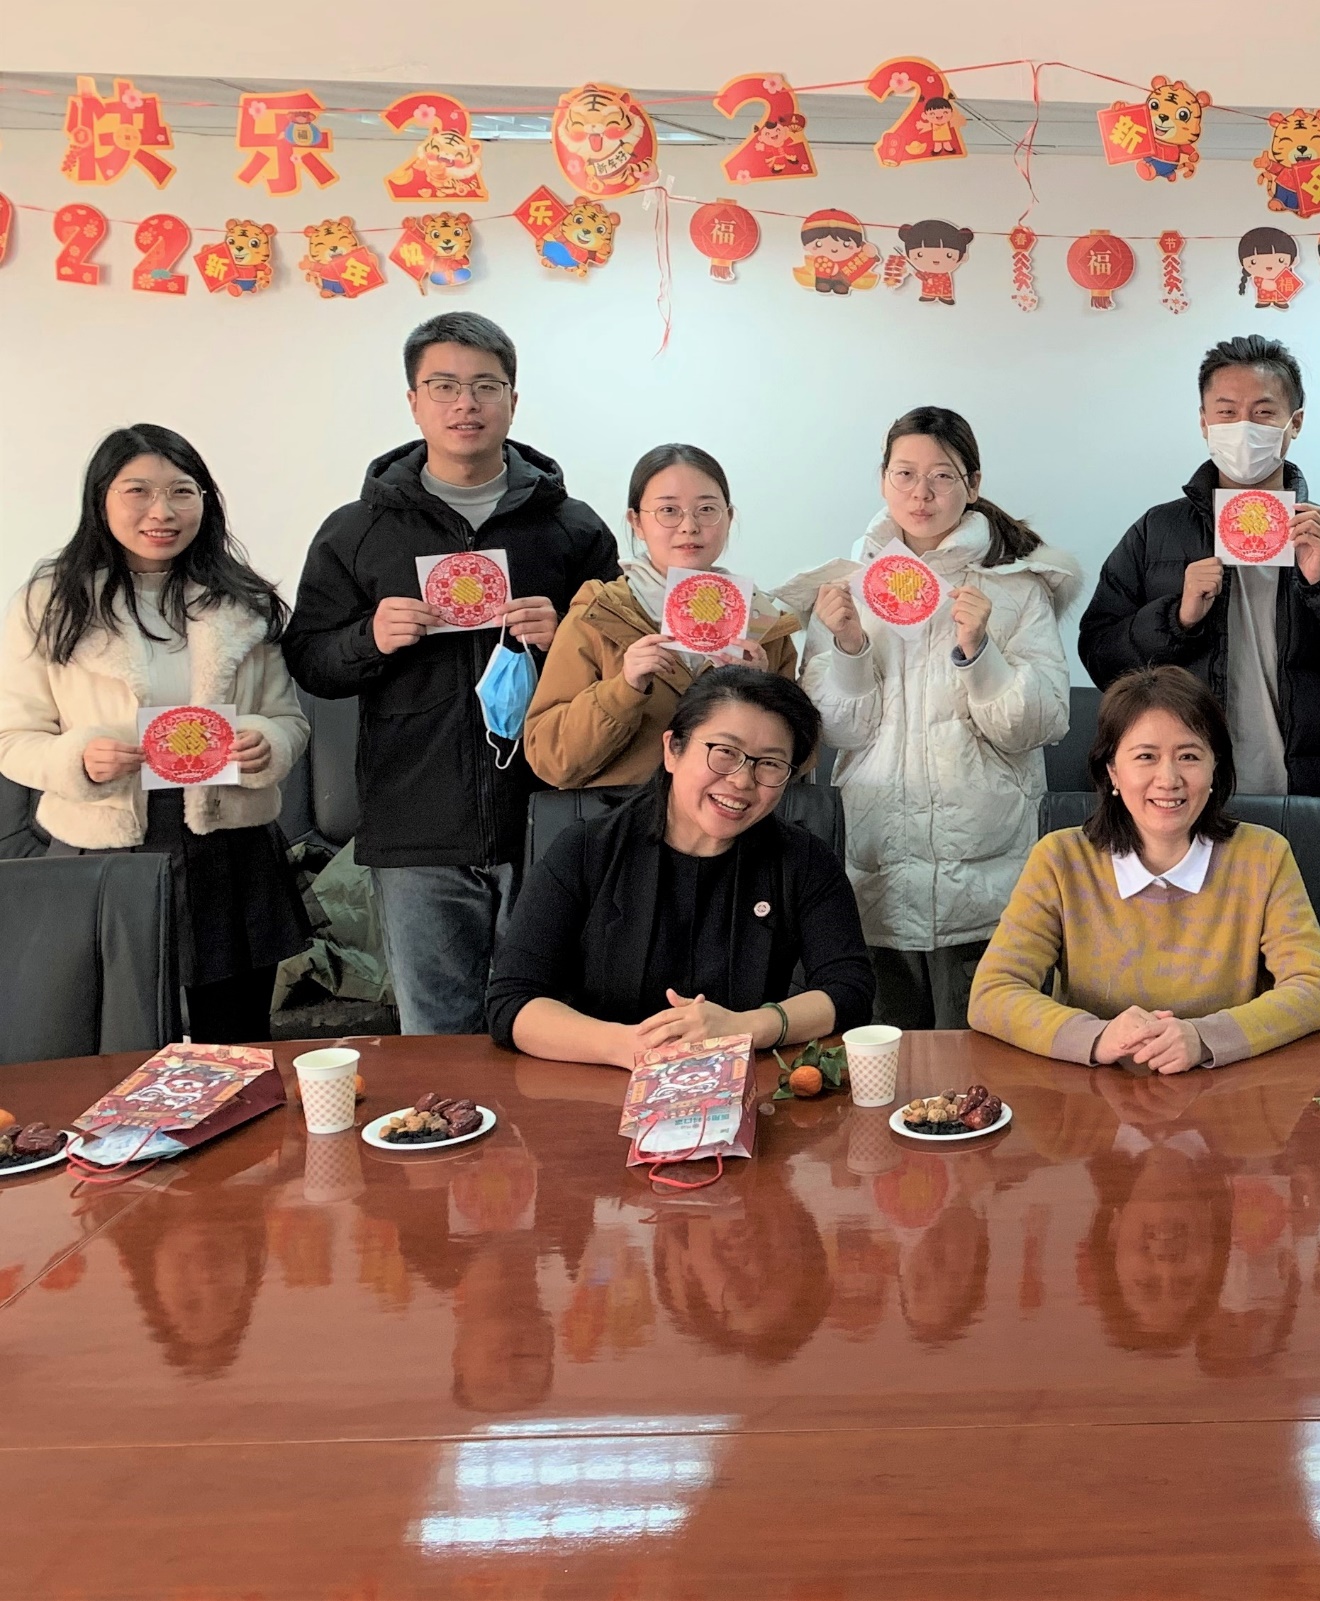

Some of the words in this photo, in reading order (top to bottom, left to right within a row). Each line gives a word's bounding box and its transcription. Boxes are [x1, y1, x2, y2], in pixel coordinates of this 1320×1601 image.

[1108, 114, 1148, 155] 新
[527, 200, 554, 226] 乐
[710, 217, 737, 246] 福
[203, 252, 230, 281] 新
[338, 256, 372, 290] 年
[1086, 249, 1113, 276] 福
[1278, 275, 1294, 292] 福
